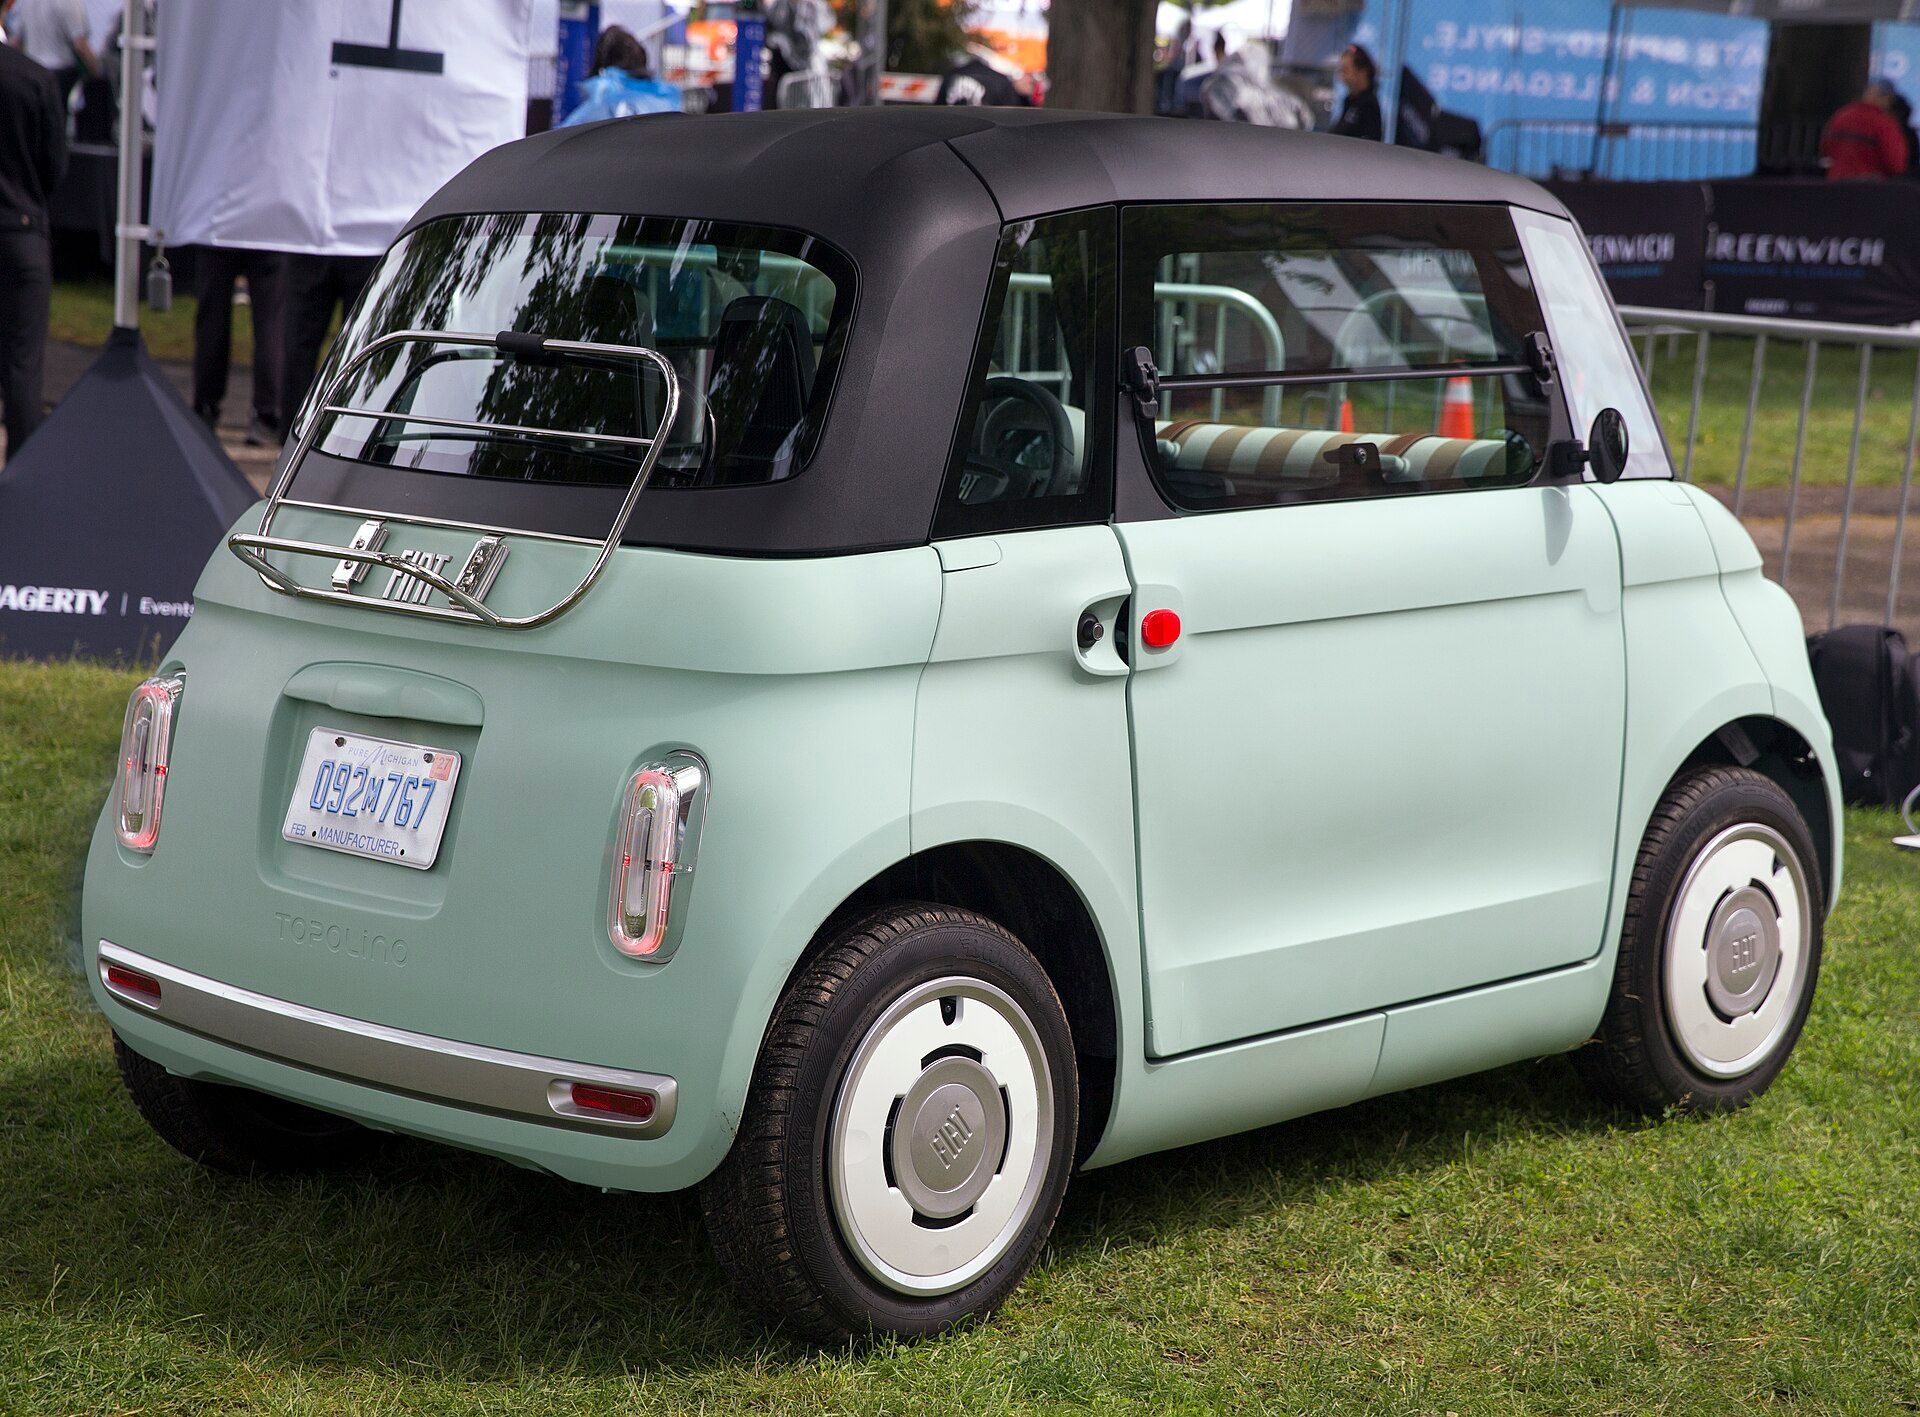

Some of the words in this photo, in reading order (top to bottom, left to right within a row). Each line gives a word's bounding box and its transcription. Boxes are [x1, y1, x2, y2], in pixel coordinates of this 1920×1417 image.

[382, 549, 453, 606] FIAT
[348, 746, 369, 758] PURE
[309, 760, 436, 828] 092M767
[291, 822, 307, 836] FEB
[317, 826, 400, 854] MANUFACTURER
